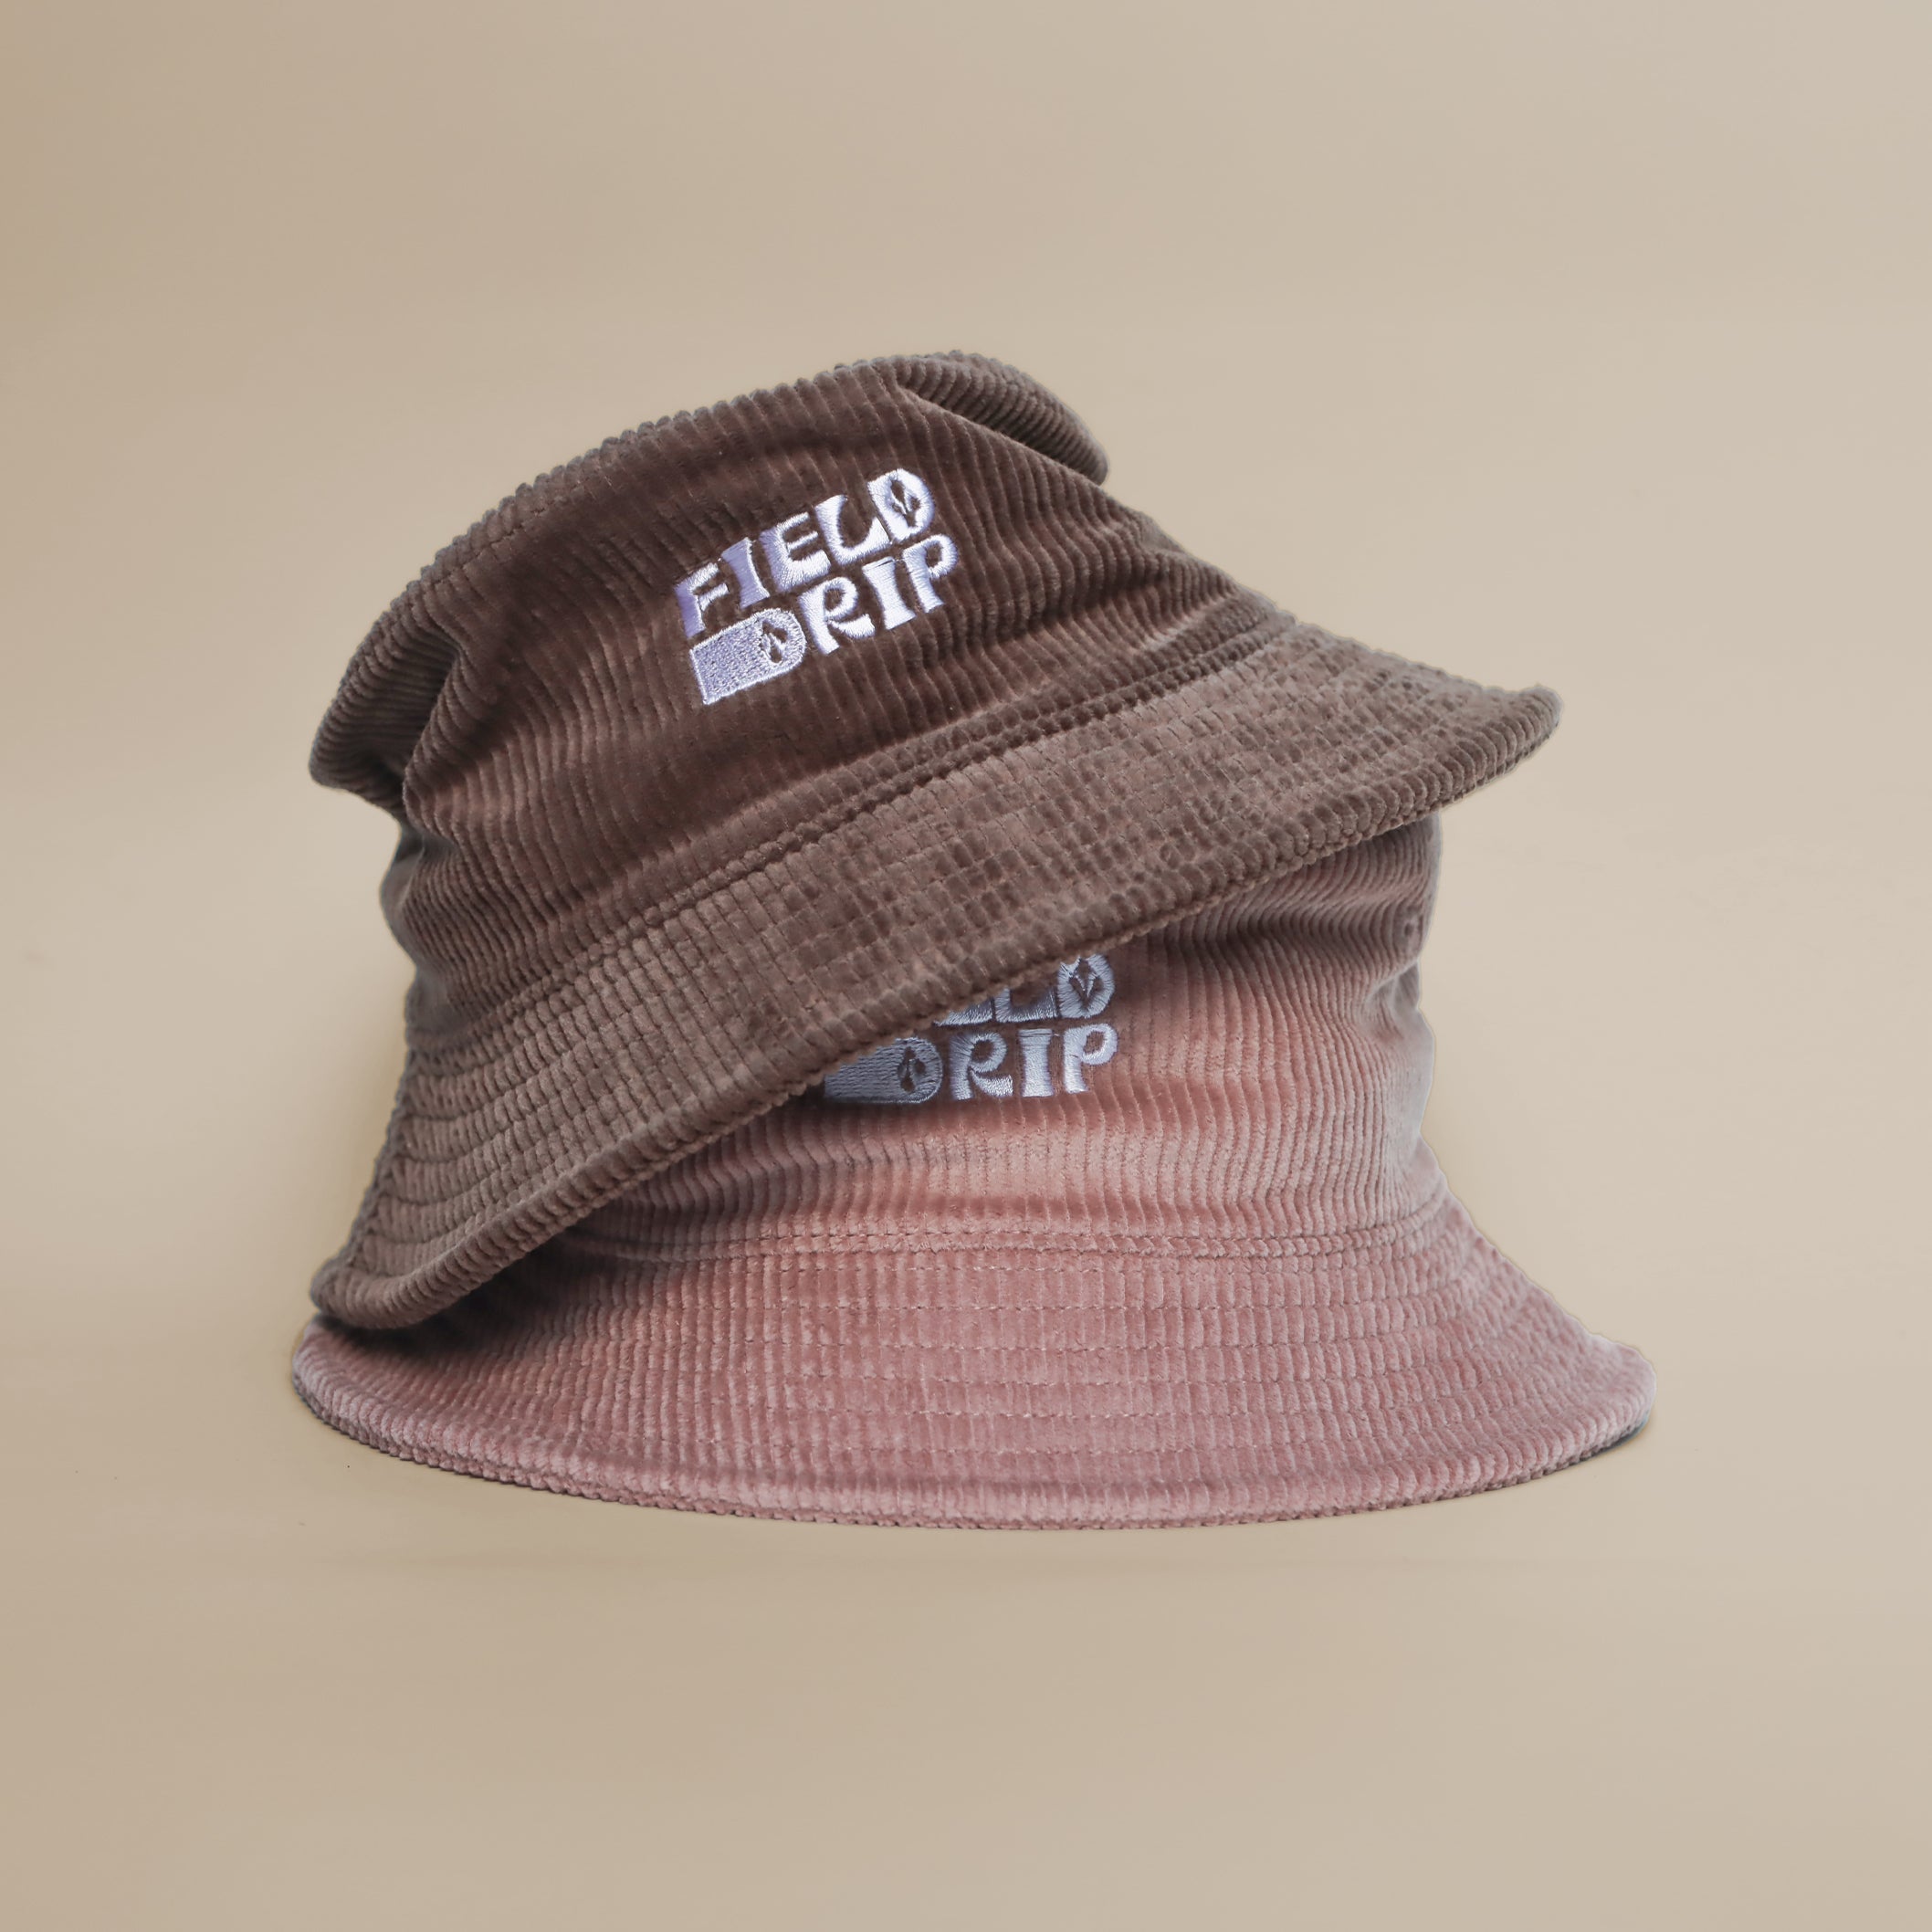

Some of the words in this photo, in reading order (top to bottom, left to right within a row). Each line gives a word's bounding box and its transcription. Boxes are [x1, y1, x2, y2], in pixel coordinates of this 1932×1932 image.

[674, 468, 935, 638] FIELD
[688, 534, 958, 705] DRIP
[824, 1023, 1118, 1104] DRIP
